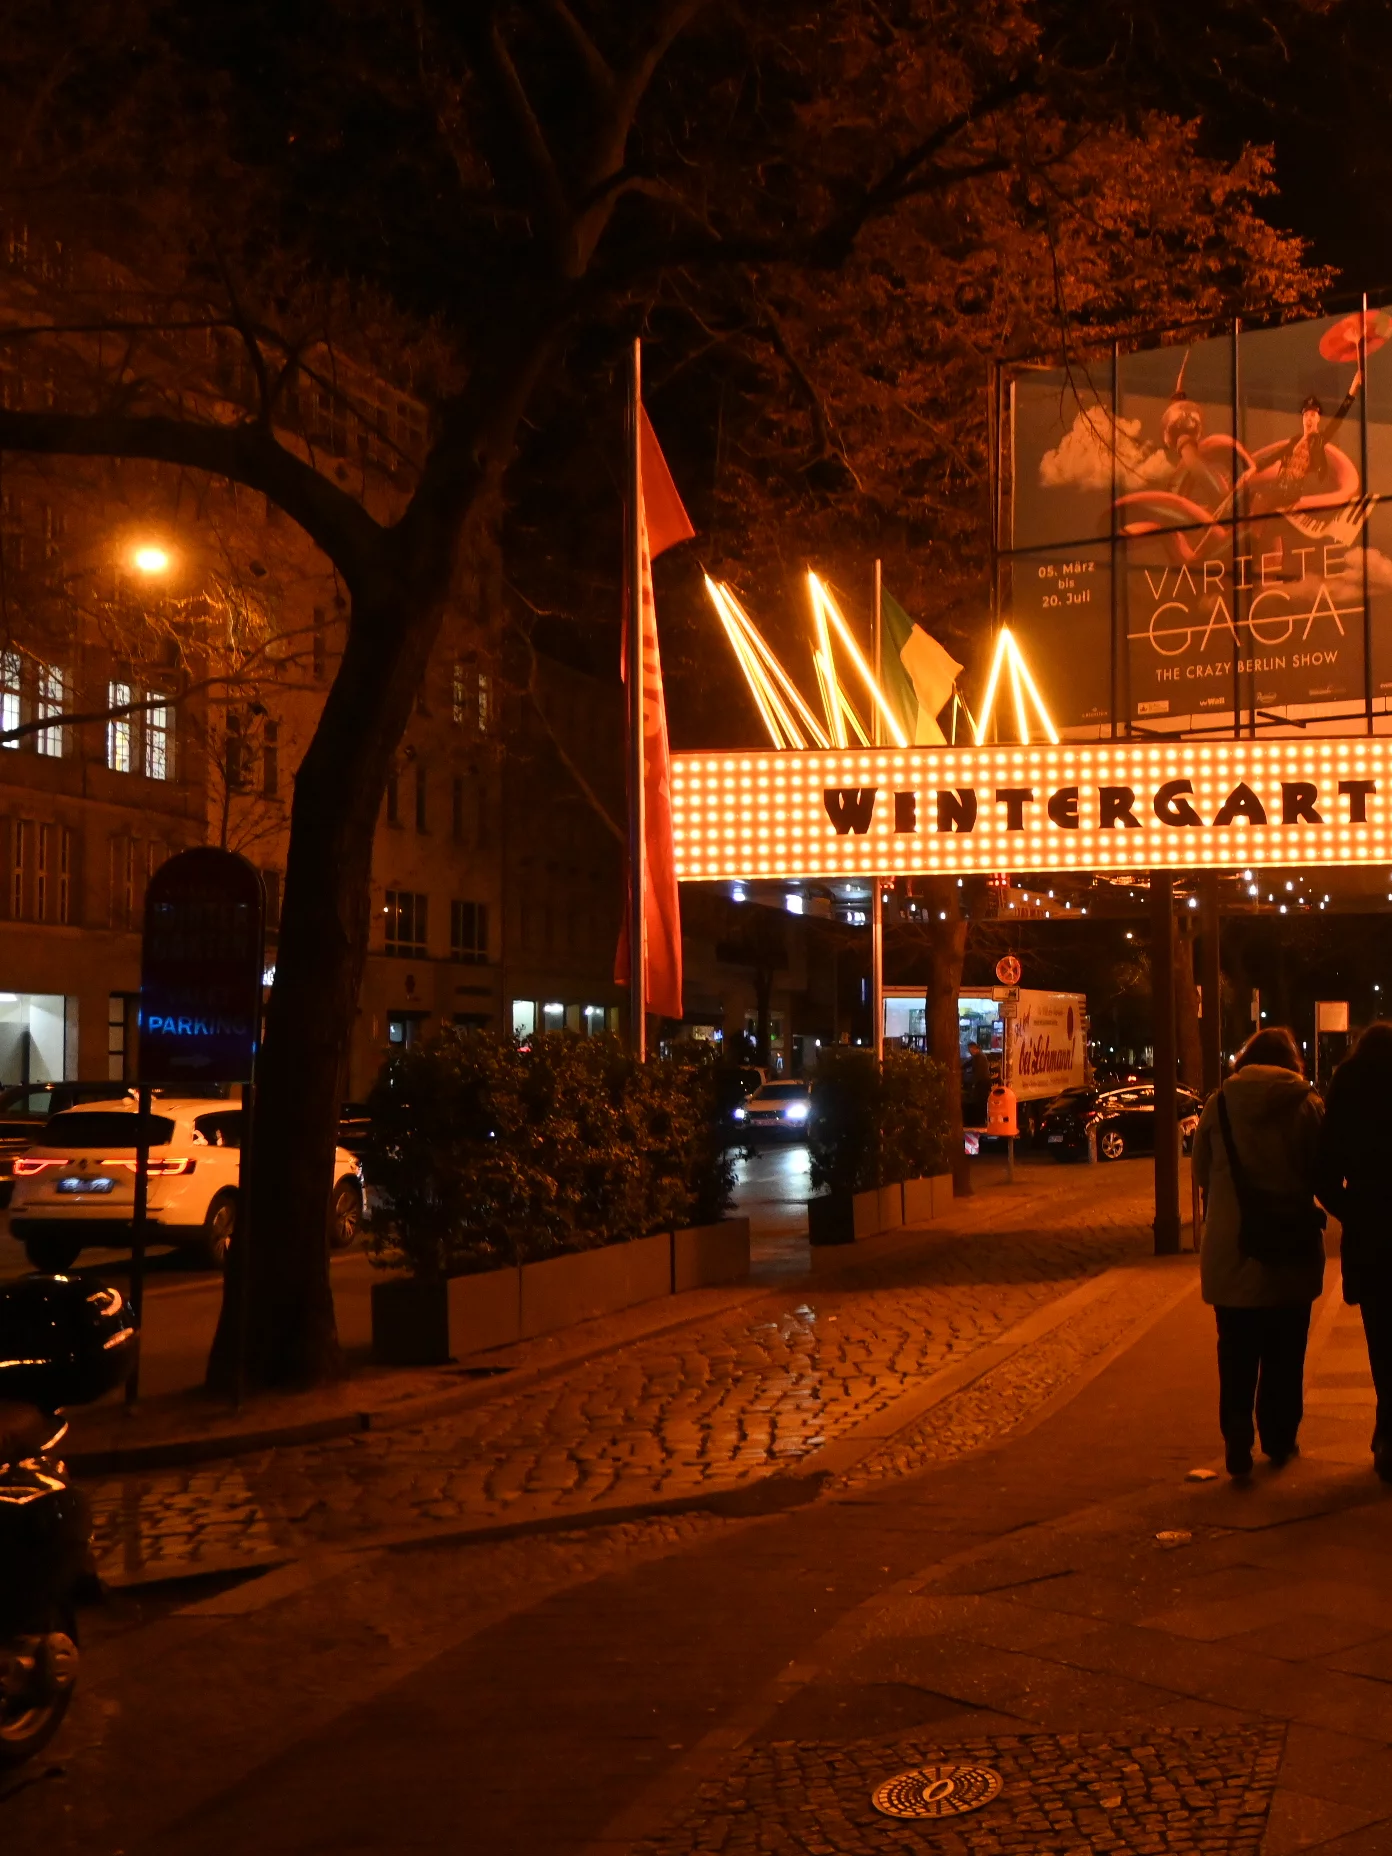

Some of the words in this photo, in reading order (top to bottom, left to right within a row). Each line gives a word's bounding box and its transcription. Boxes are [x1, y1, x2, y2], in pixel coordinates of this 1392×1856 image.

[1038, 565, 1058, 578] 05.
[1062, 561, 1095, 575] März
[1058, 577, 1075, 589] bis
[1042, 595, 1062, 608] 20.
[1066, 589, 1091, 605] Juli
[1149, 584, 1345, 656] GAGA
[1155, 667, 1180, 682] THE
[1186, 661, 1232, 678] CRAZY
[1237, 656, 1287, 673] BERLIN
[1292, 650, 1338, 668] SHOW
[148, 1015, 247, 1036] PARKING
